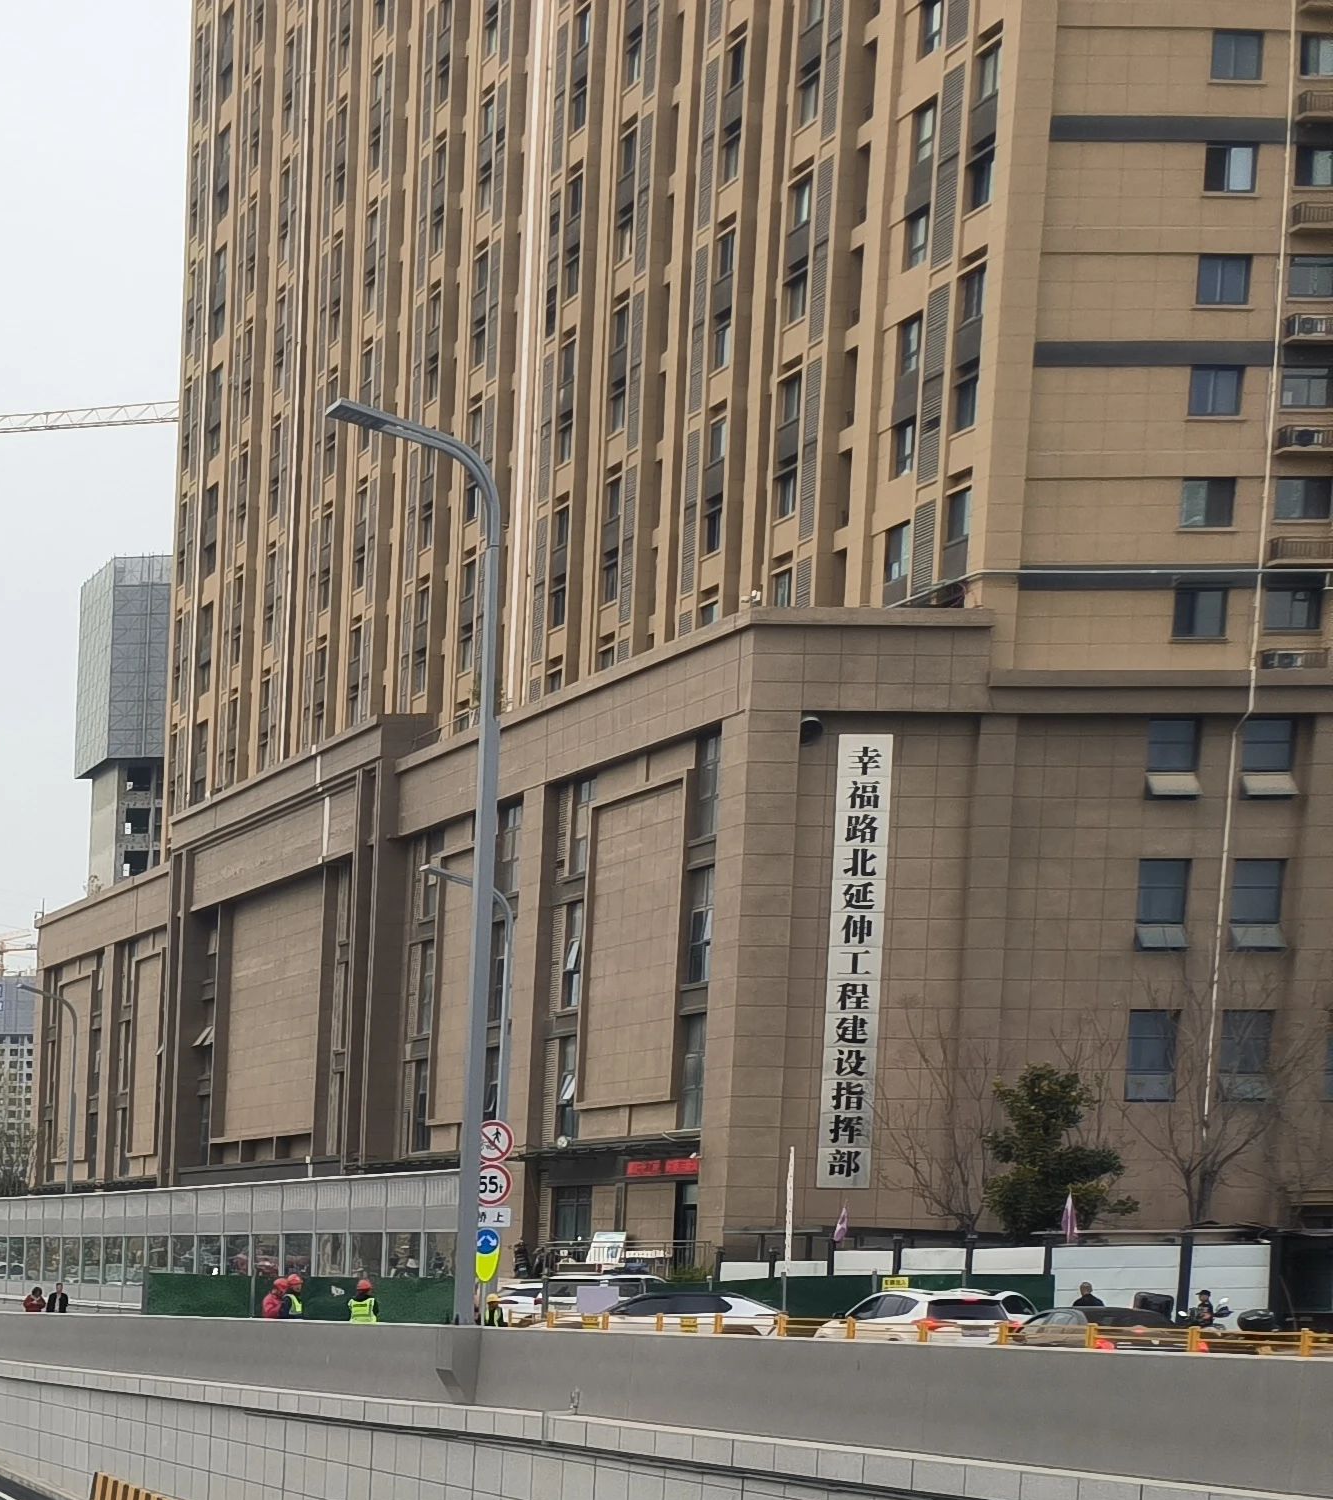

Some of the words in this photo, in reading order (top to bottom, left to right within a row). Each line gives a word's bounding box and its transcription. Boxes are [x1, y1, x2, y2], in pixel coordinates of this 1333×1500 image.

[827, 745, 881, 1178] 幸福路北延伸工程建设指挥部
[479, 1176, 504, 1193] 55t
